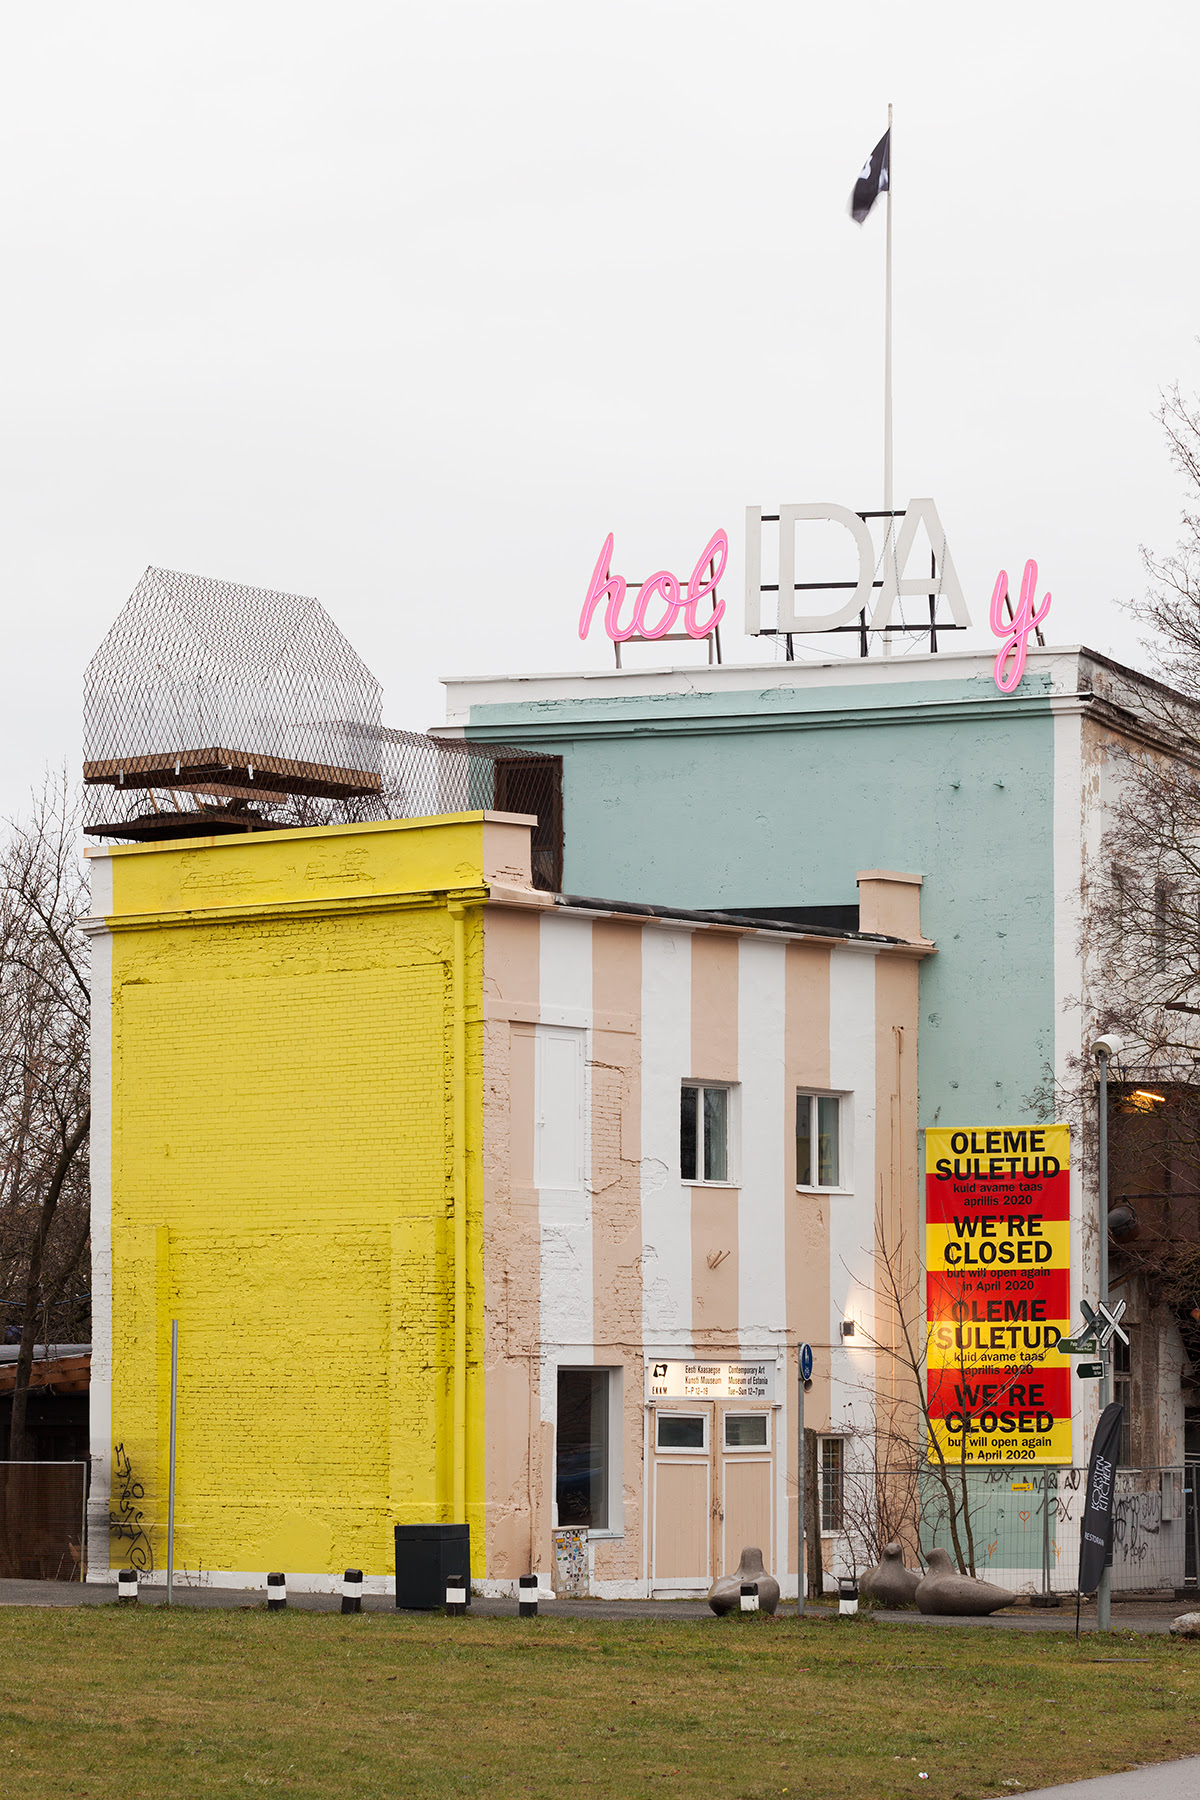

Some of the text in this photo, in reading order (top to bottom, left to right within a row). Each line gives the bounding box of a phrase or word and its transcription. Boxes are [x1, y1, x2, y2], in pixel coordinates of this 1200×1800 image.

[950, 1130, 1046, 1154] OLEME
[935, 1156, 1061, 1181] SULETUD
[953, 1182, 1043, 1193] kuid avame taas
[963, 1195, 1033, 1208] aprillis 2020
[953, 1214, 1043, 1238] WE'RE
[944, 1241, 1053, 1265] CLOSED
[947, 1267, 1050, 1280] but will open again
[963, 1280, 1034, 1293] in April 2020
[951, 1299, 1047, 1322] OLEME
[935, 1326, 1062, 1350] SULETUD
[954, 1351, 1044, 1362] kuid avame taas
[685, 1365, 696, 1374] Eesti
[728, 1365, 758, 1376] Contemporary
[964, 1364, 1034, 1376] aprillis 2020
[728, 1376, 747, 1385] Museum
[753, 1376, 768, 1385] Estonia
[945, 1411, 1054, 1433] CLOSED
[948, 1436, 1052, 1449] bu will open again
[977, 1450, 1002, 1462] April
[1006, 1450, 1035, 1460] 2020
